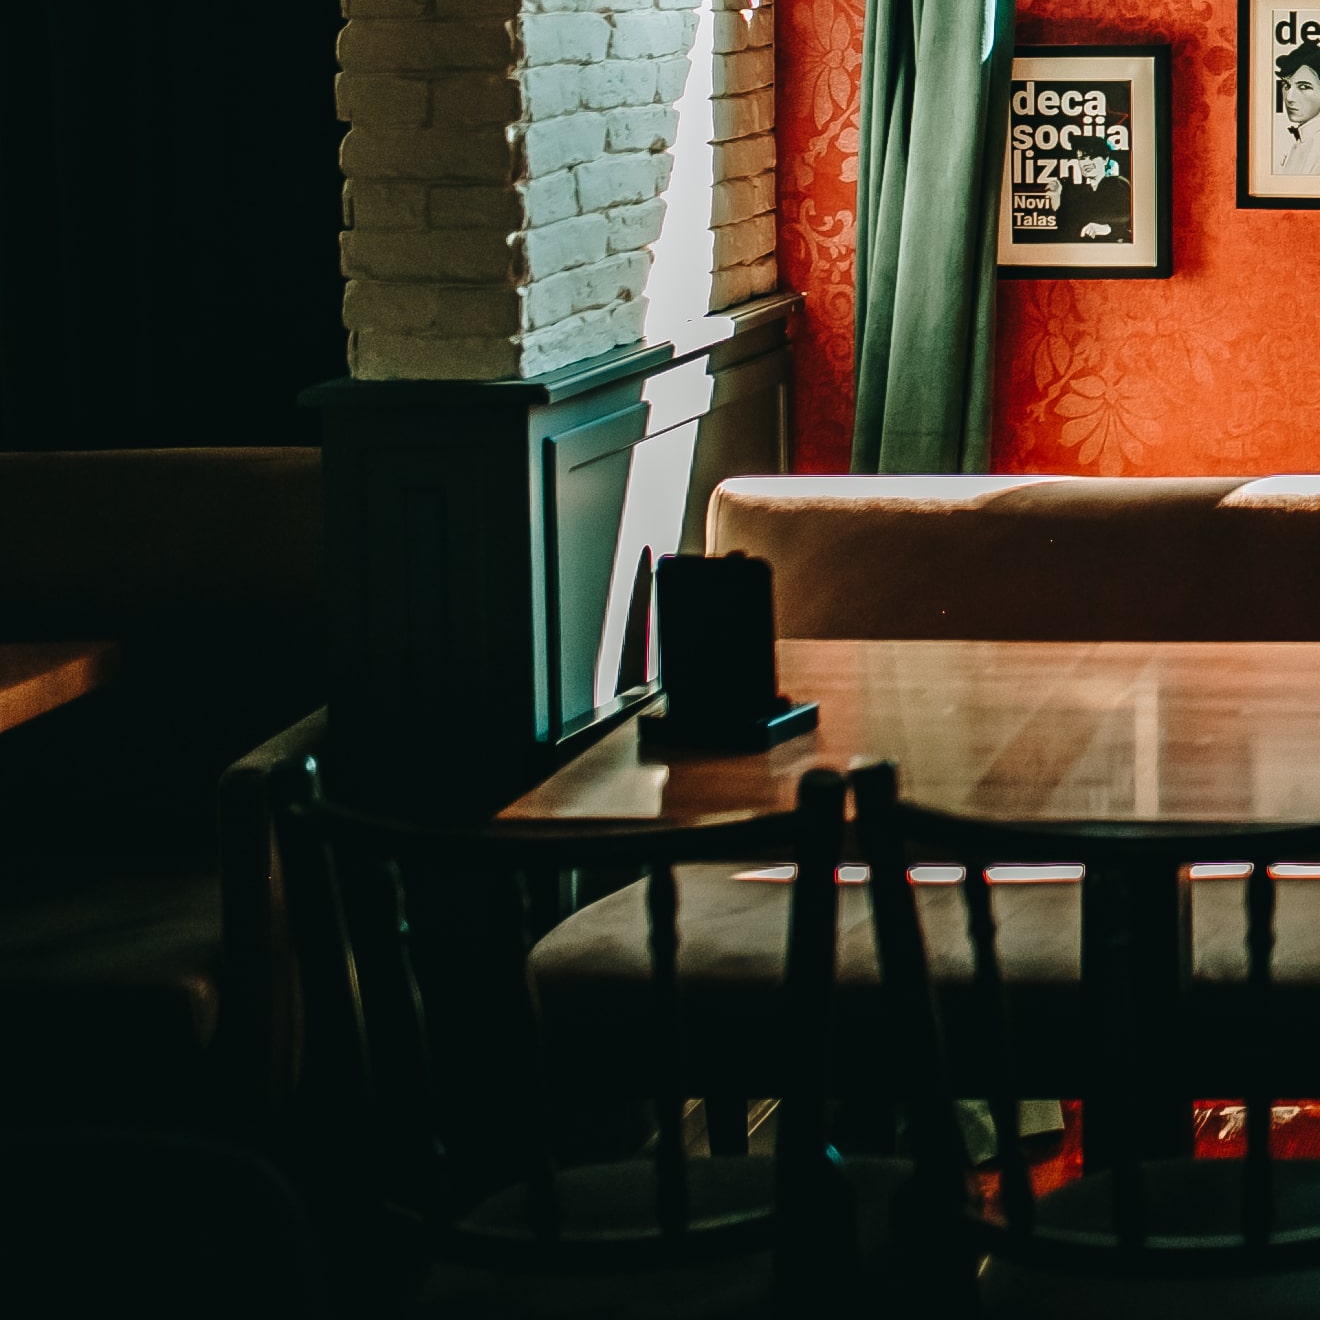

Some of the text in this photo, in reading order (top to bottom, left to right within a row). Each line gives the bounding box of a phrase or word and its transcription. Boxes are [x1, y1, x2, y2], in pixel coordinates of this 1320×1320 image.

[1012, 81, 1106, 116] deca
[1014, 195, 1050, 209] Novi
[1014, 212, 1057, 226] Talas
